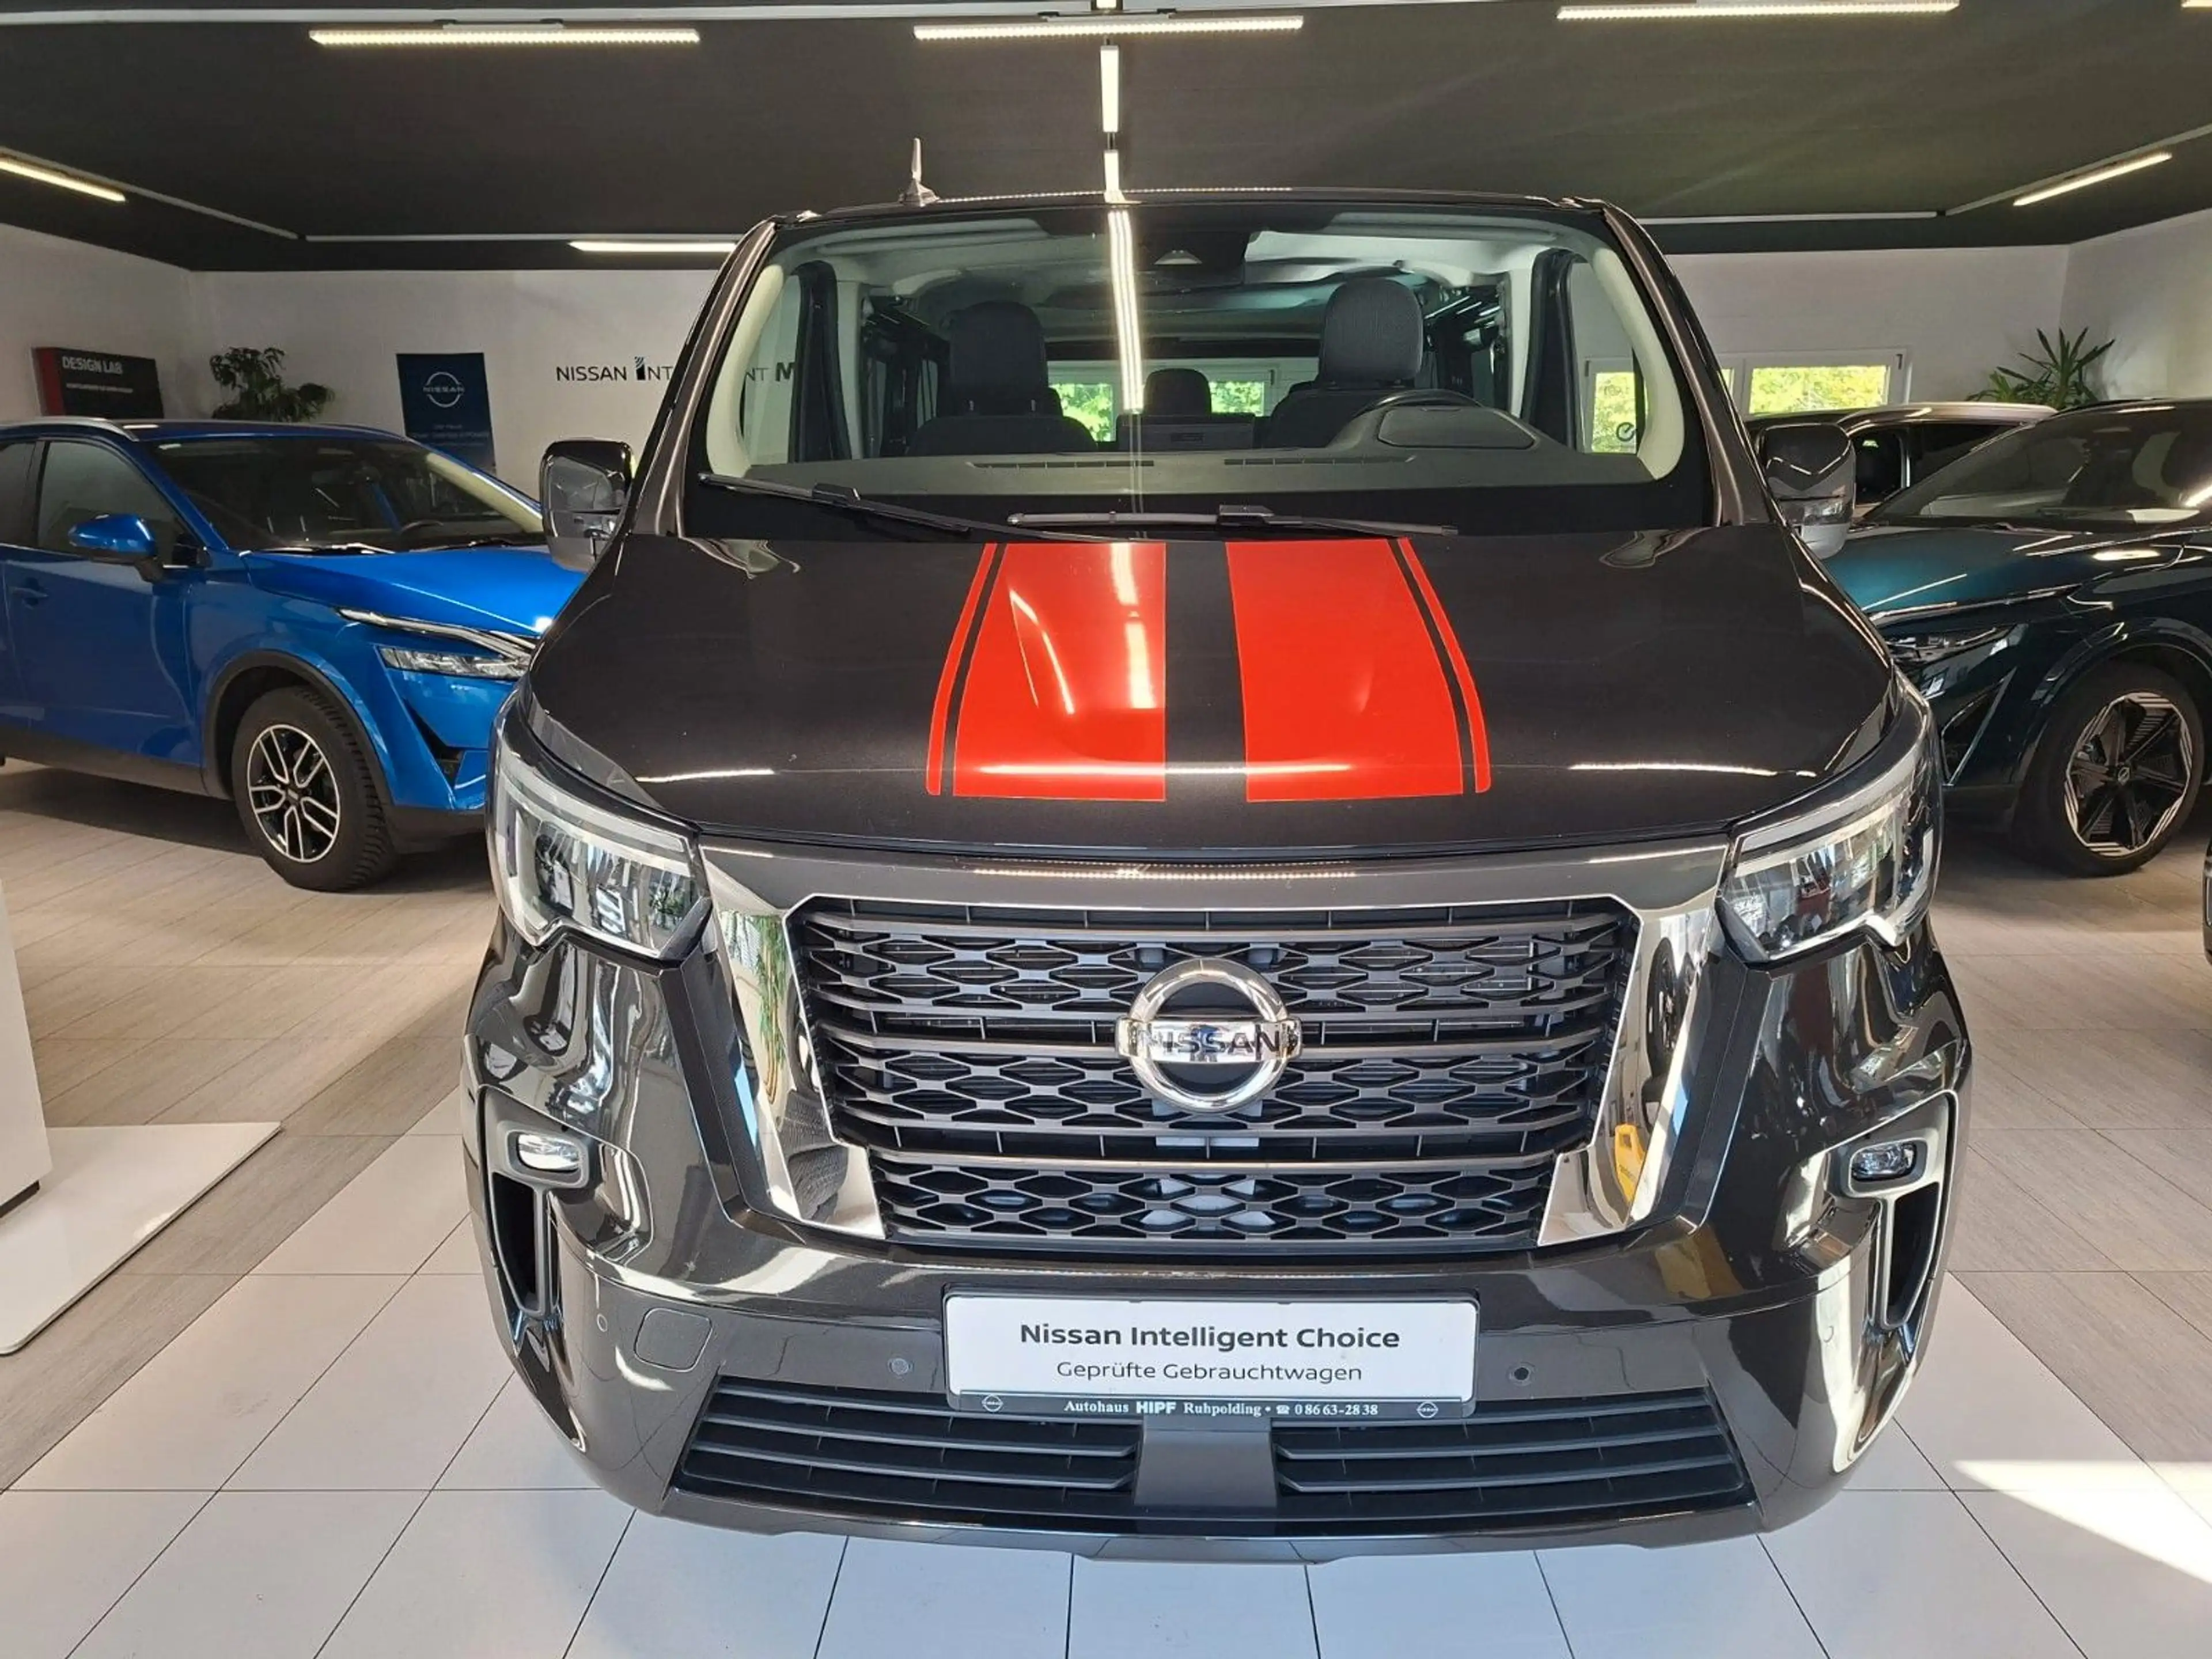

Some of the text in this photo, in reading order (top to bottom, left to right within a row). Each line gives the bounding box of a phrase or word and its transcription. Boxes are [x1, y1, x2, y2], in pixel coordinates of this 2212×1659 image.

[62, 356, 123, 374] DESIGN LAB
[556, 366, 627, 381] NISSAN
[1137, 1029, 1281, 1055] NISSAN
[1020, 1323, 1400, 1352] Nissan Intelligent Choice
[1056, 1361, 1362, 1384] Geprüfte Gebrauchtwagen
[1063, 1400, 1129, 1413] Autohaus
[1136, 1401, 1176, 1414] HIPF
[1183, 1403, 1262, 1418] Ruhpolding
